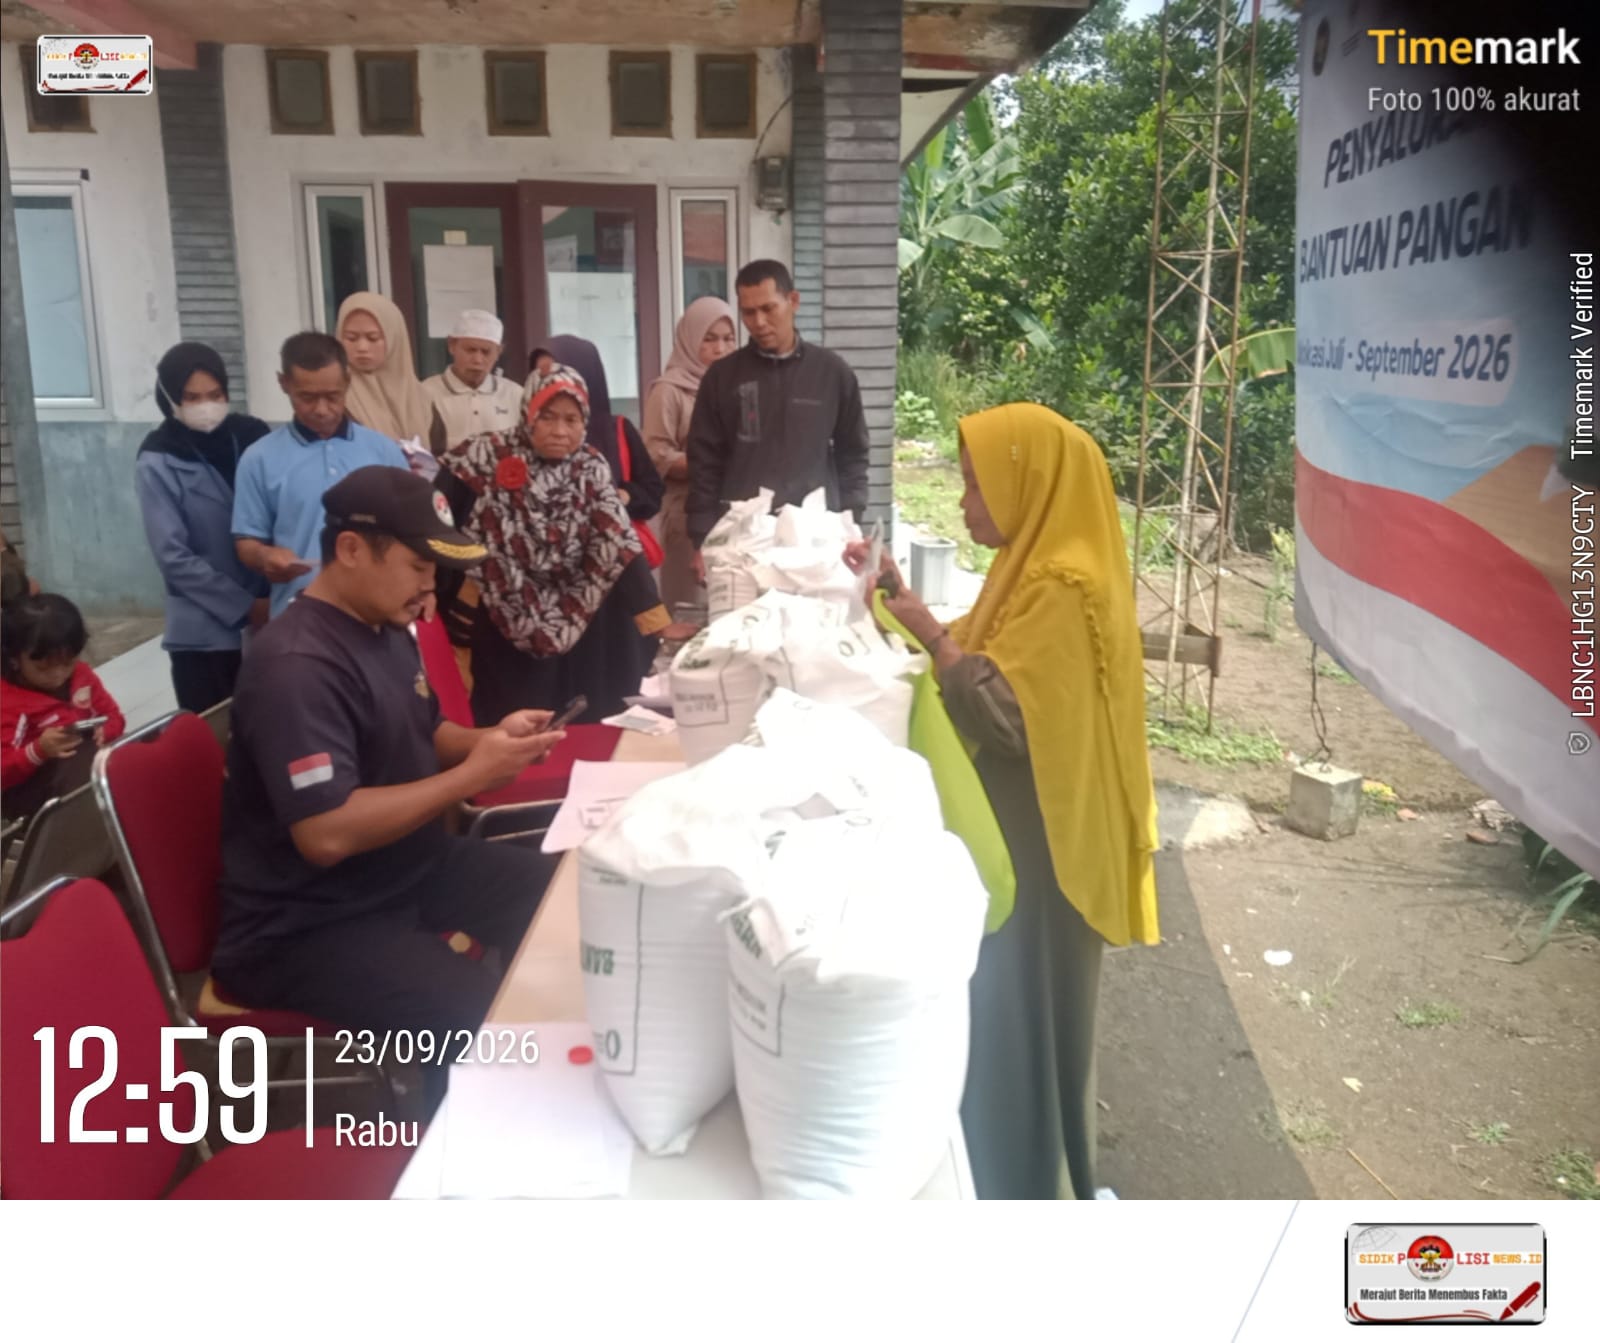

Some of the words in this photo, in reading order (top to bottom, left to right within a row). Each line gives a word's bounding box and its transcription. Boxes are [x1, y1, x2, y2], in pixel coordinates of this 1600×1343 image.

[1393, 184, 1531, 269] PANGAN
[1354, 337, 1445, 382] September
[1447, 333, 1512, 382] 2026
